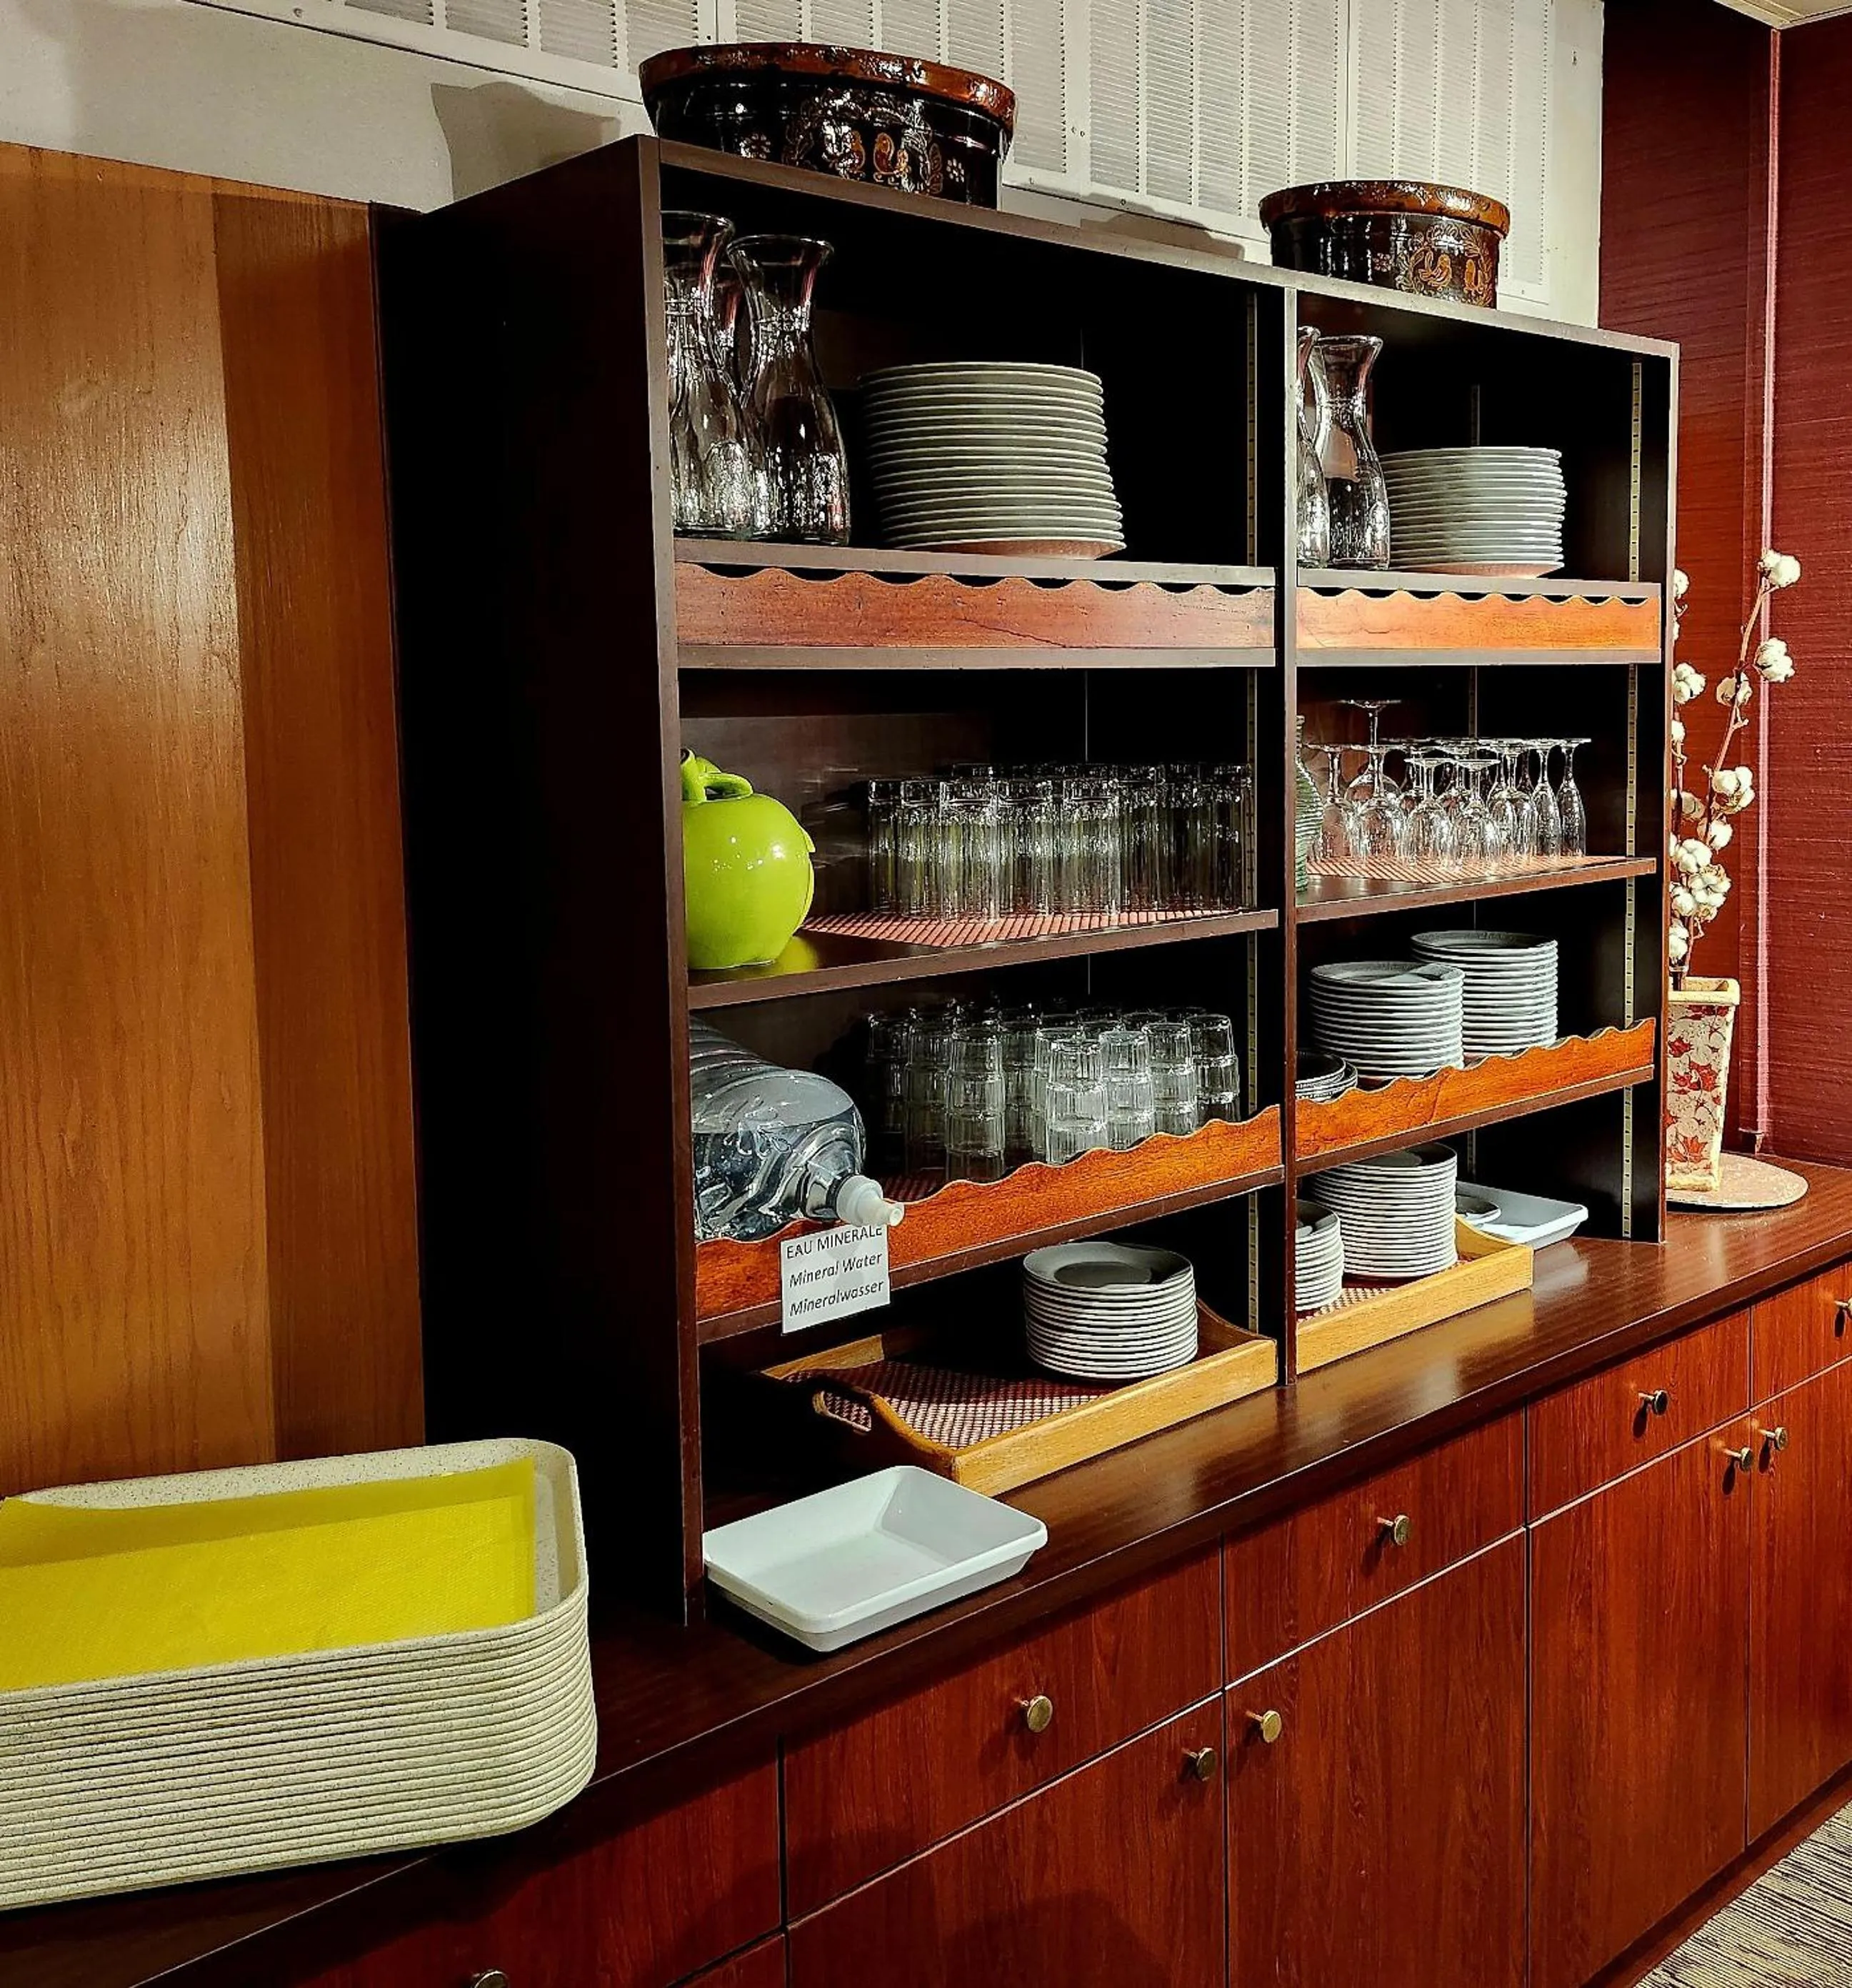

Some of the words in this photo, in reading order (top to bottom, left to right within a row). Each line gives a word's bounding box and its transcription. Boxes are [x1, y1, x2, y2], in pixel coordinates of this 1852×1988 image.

[787, 1240, 812, 1259] EAU
[789, 1260, 839, 1288] Mineral
[843, 1252, 883, 1273] Water
[789, 1281, 884, 1317] Mineralwasser
